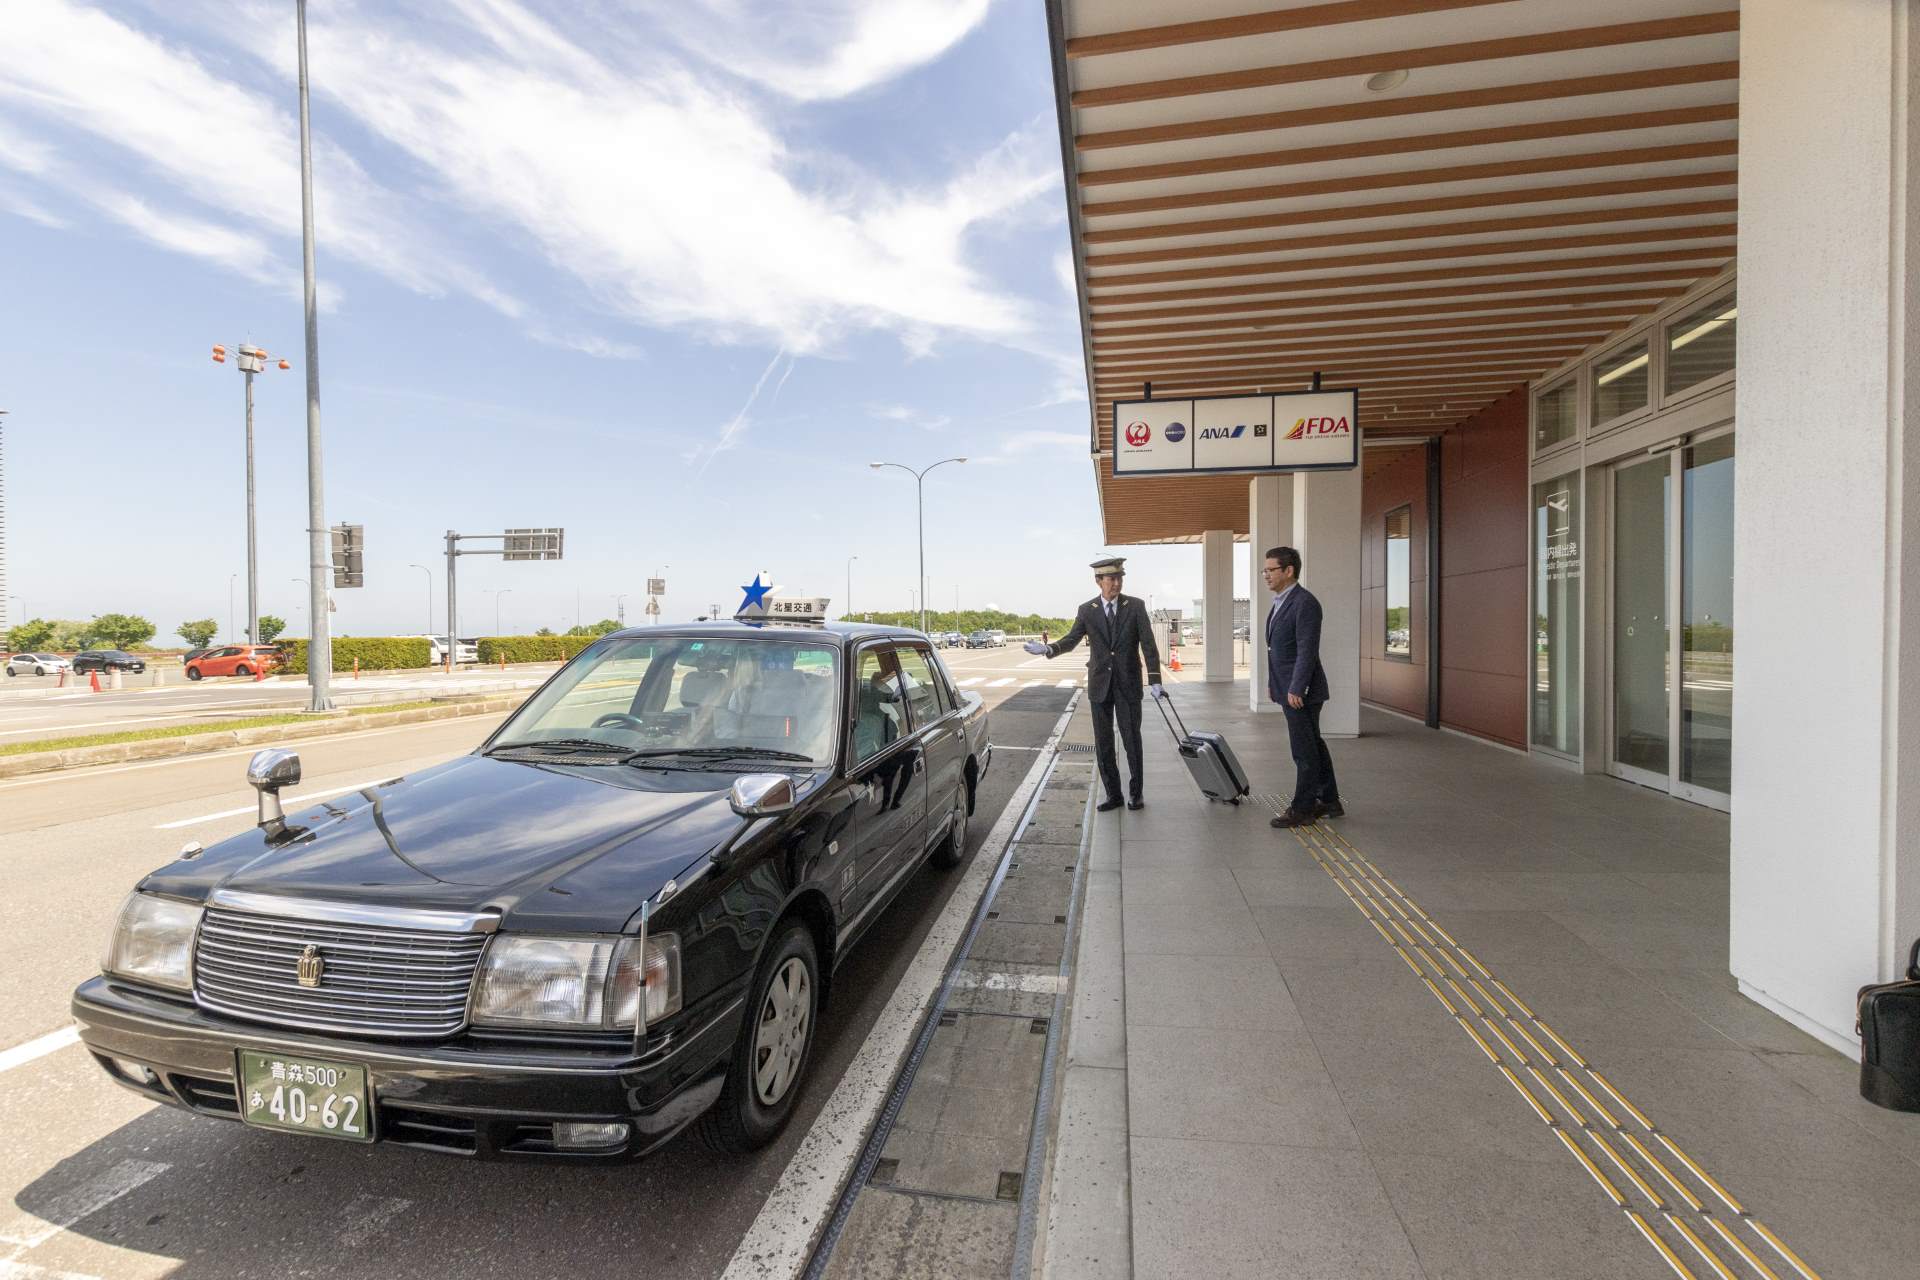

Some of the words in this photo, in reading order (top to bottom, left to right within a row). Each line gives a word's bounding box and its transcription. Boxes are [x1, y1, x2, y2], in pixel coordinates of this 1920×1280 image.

[1307, 416, 1349, 434] FDA
[1199, 427, 1230, 440] ANA
[774, 602, 812, 613] 北星交通
[251, 1090, 265, 1109] あ
[270, 1085, 360, 1133] 40-62
